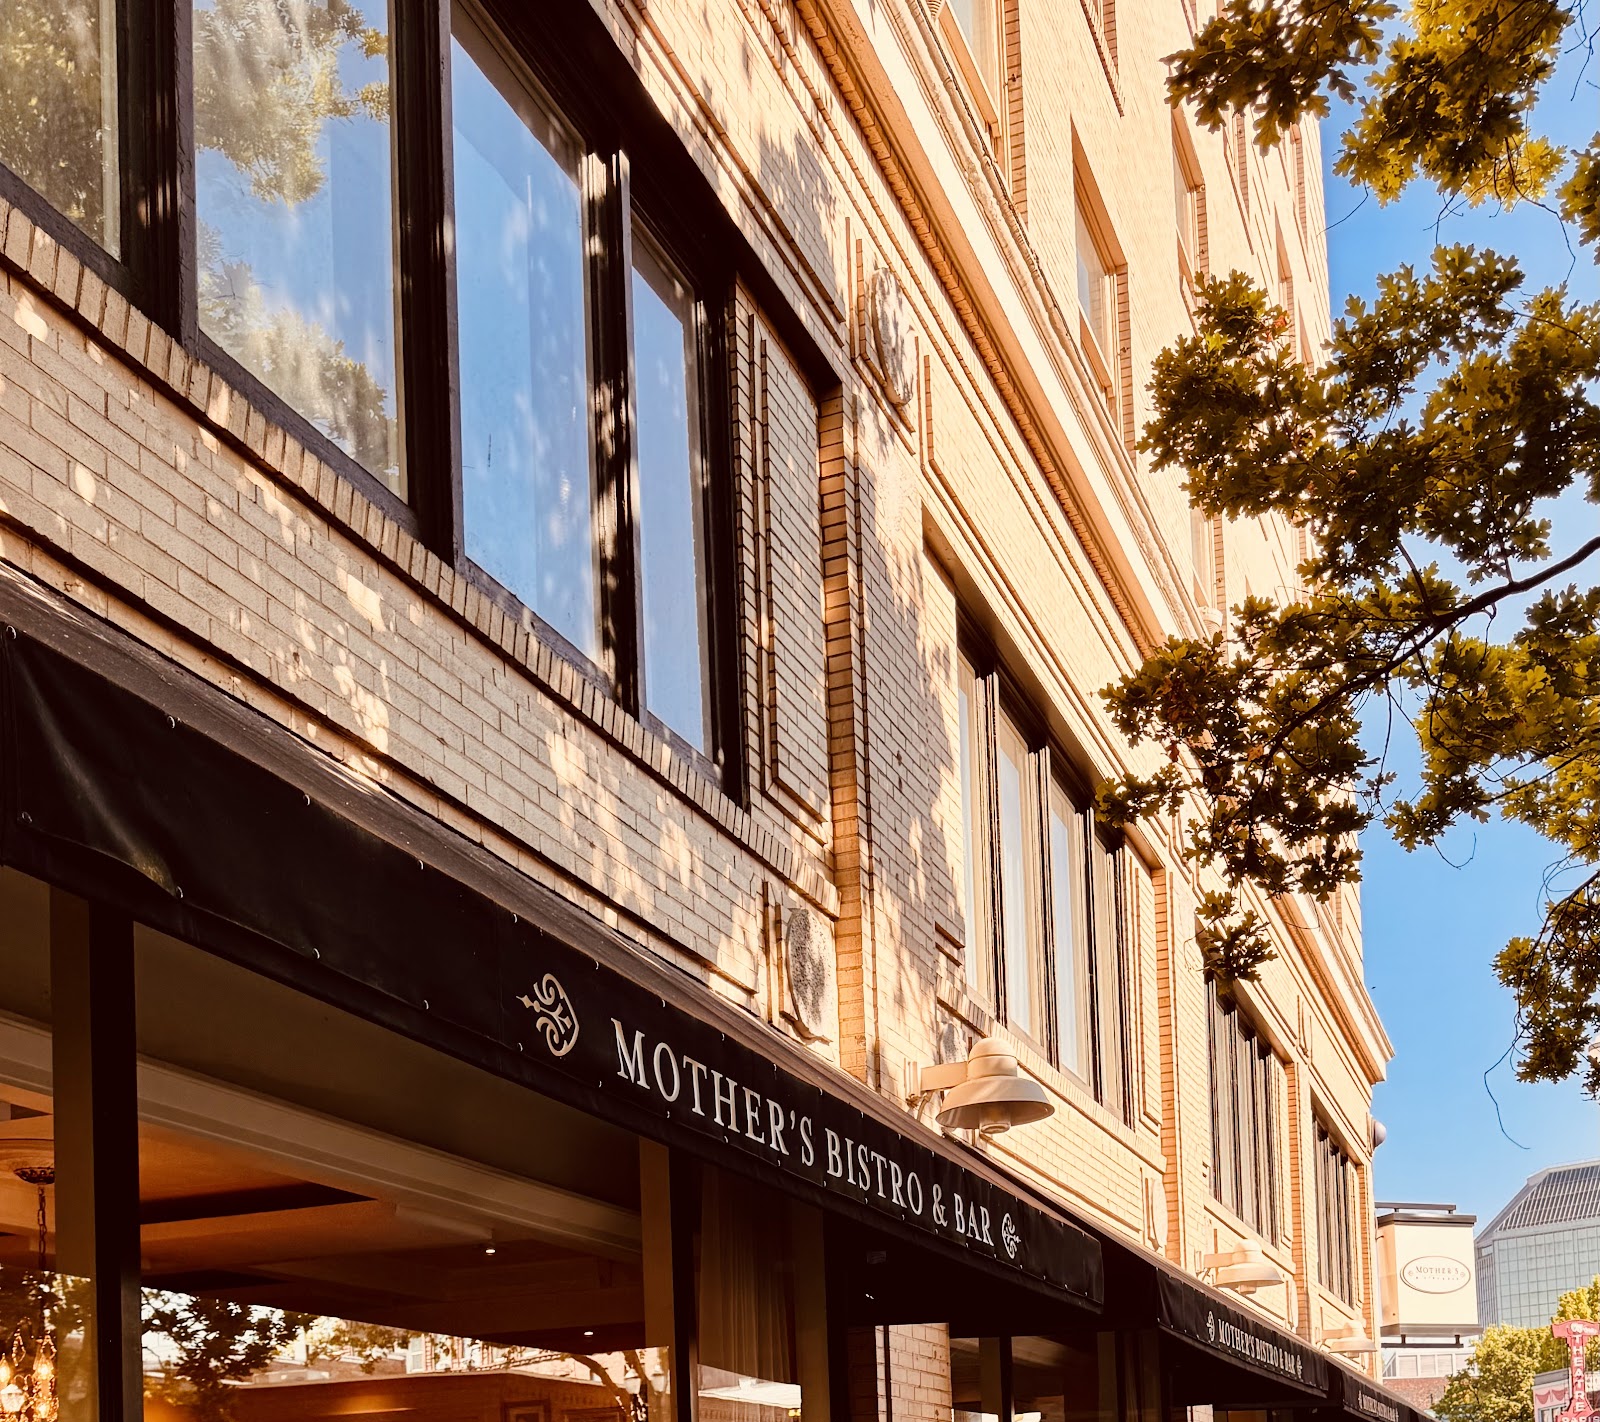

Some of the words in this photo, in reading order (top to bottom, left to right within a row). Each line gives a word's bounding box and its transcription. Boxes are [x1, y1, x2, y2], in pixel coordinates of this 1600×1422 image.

[611, 1017, 815, 1167] MOTHER'S
[825, 1128, 924, 1216] BISTRO
[932, 1183, 948, 1228] &
[953, 1192, 995, 1247] BAR
[1415, 1265, 1459, 1275] MOTHERS
[1218, 1318, 1256, 1359] MOTHER'S
[1572, 1334, 1586, 1412] THEATRE
